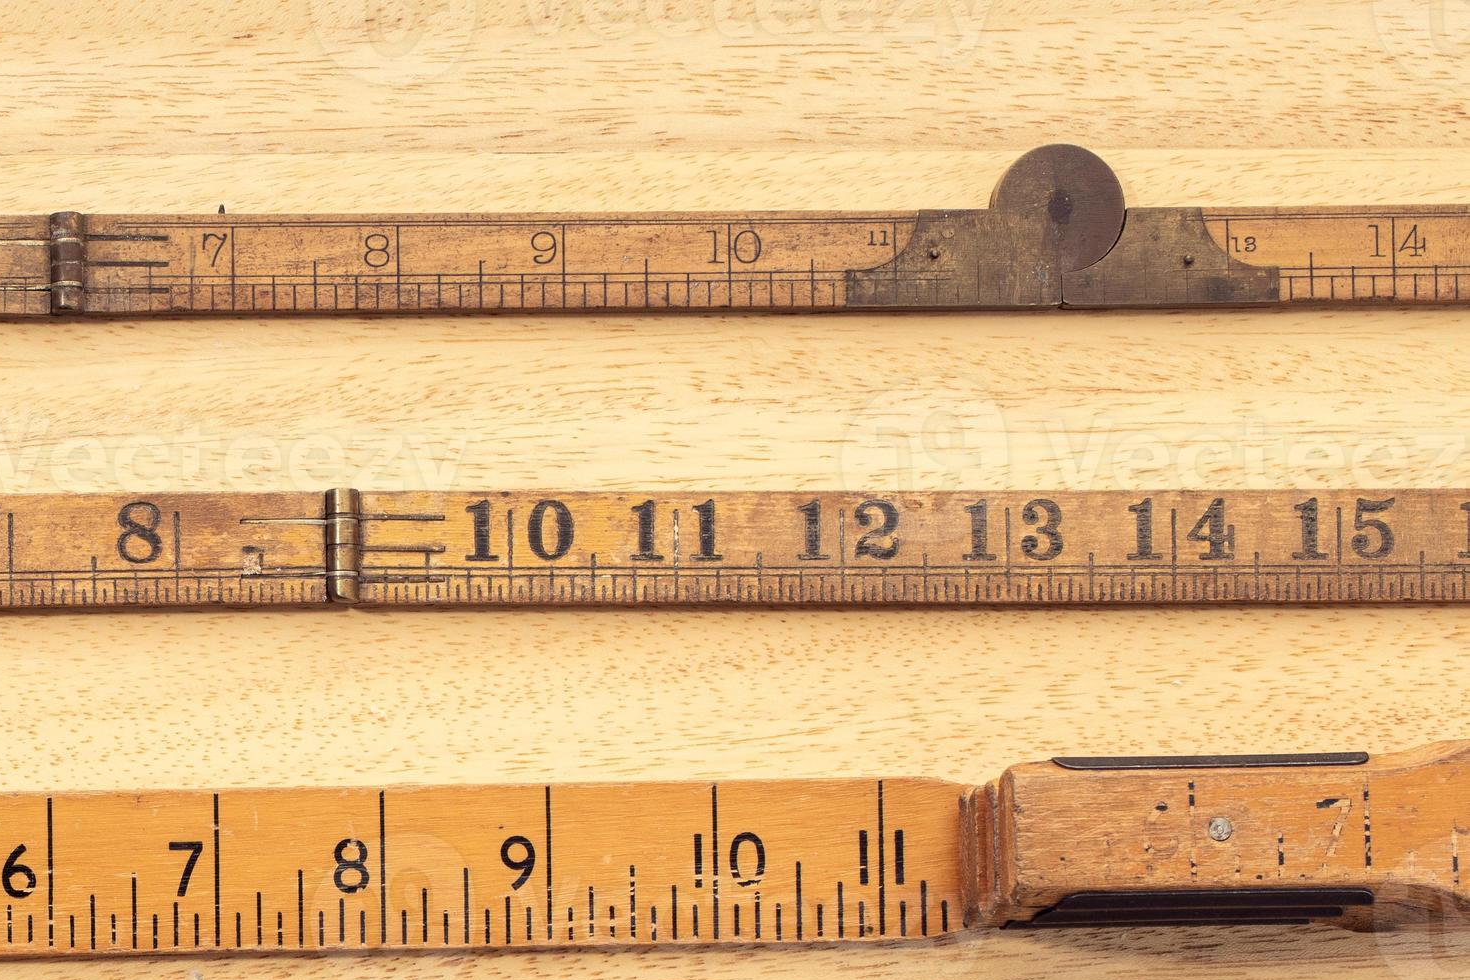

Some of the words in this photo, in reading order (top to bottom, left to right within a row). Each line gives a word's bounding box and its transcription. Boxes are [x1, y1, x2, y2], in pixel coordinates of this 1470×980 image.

[201, 233, 228, 267] 7
[363, 233, 390, 268] 8
[533, 231, 558, 265] 9
[706, 230, 762, 265] 10
[867, 230, 890, 247] 11
[1231, 235, 1257, 253] 13
[1368, 224, 1426, 258] 14
[117, 502, 163, 564] 8
[465, 499, 576, 562] 10
[631, 499, 724, 561] 11
[797, 499, 901, 561] 12
[962, 498, 1065, 561] 13
[1127, 497, 1236, 561] 14
[1293, 496, 1396, 560] 15
[2, 843, 38, 900] 6
[167, 841, 204, 898] 7
[333, 838, 369, 894] 8
[500, 835, 536, 891] 9
[694, 831, 766, 889] 10
[858, 829, 905, 885] 11
